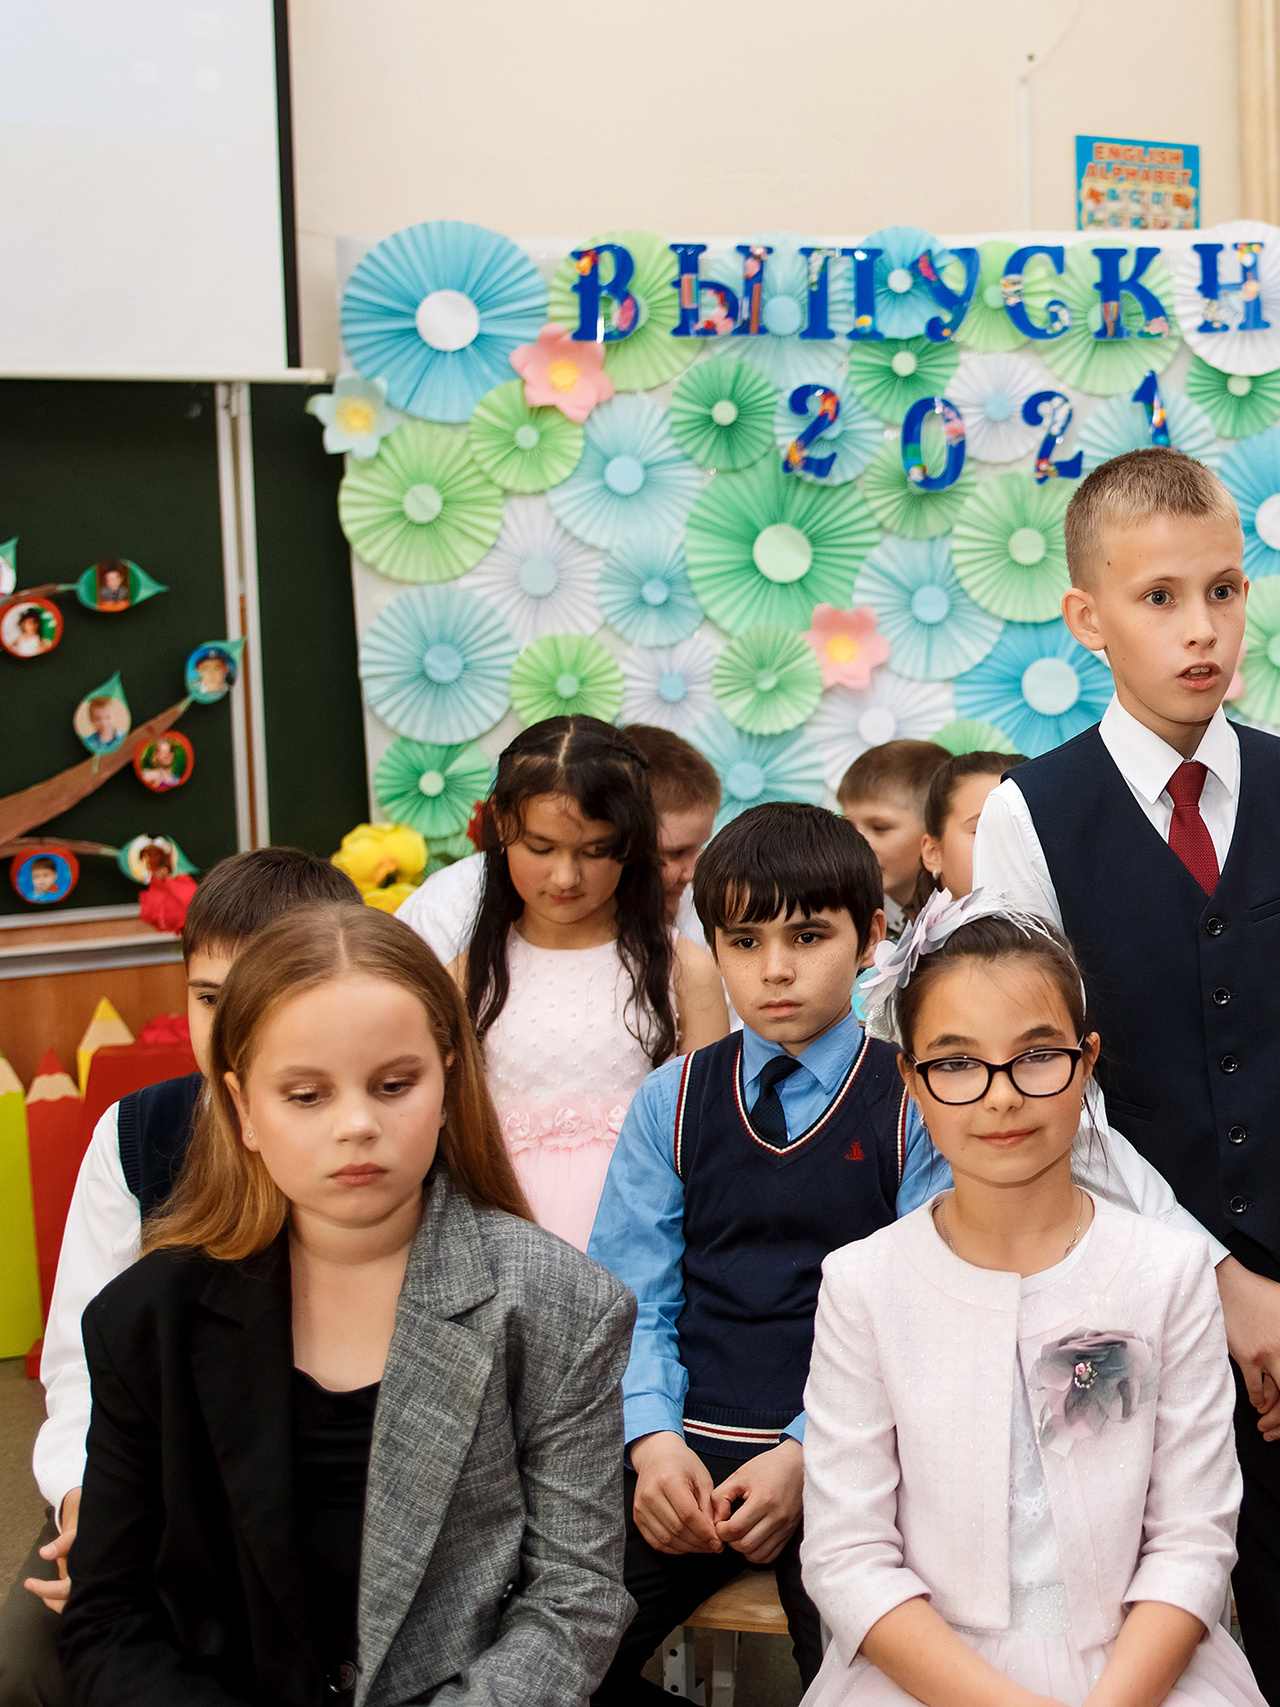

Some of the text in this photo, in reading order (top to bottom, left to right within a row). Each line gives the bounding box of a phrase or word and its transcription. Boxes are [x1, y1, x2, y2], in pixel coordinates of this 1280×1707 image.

[1094, 144, 1183, 166] ENGLISH
[1085, 162, 1191, 185] ALPHABET
[782, 370, 1174, 491] 2021
